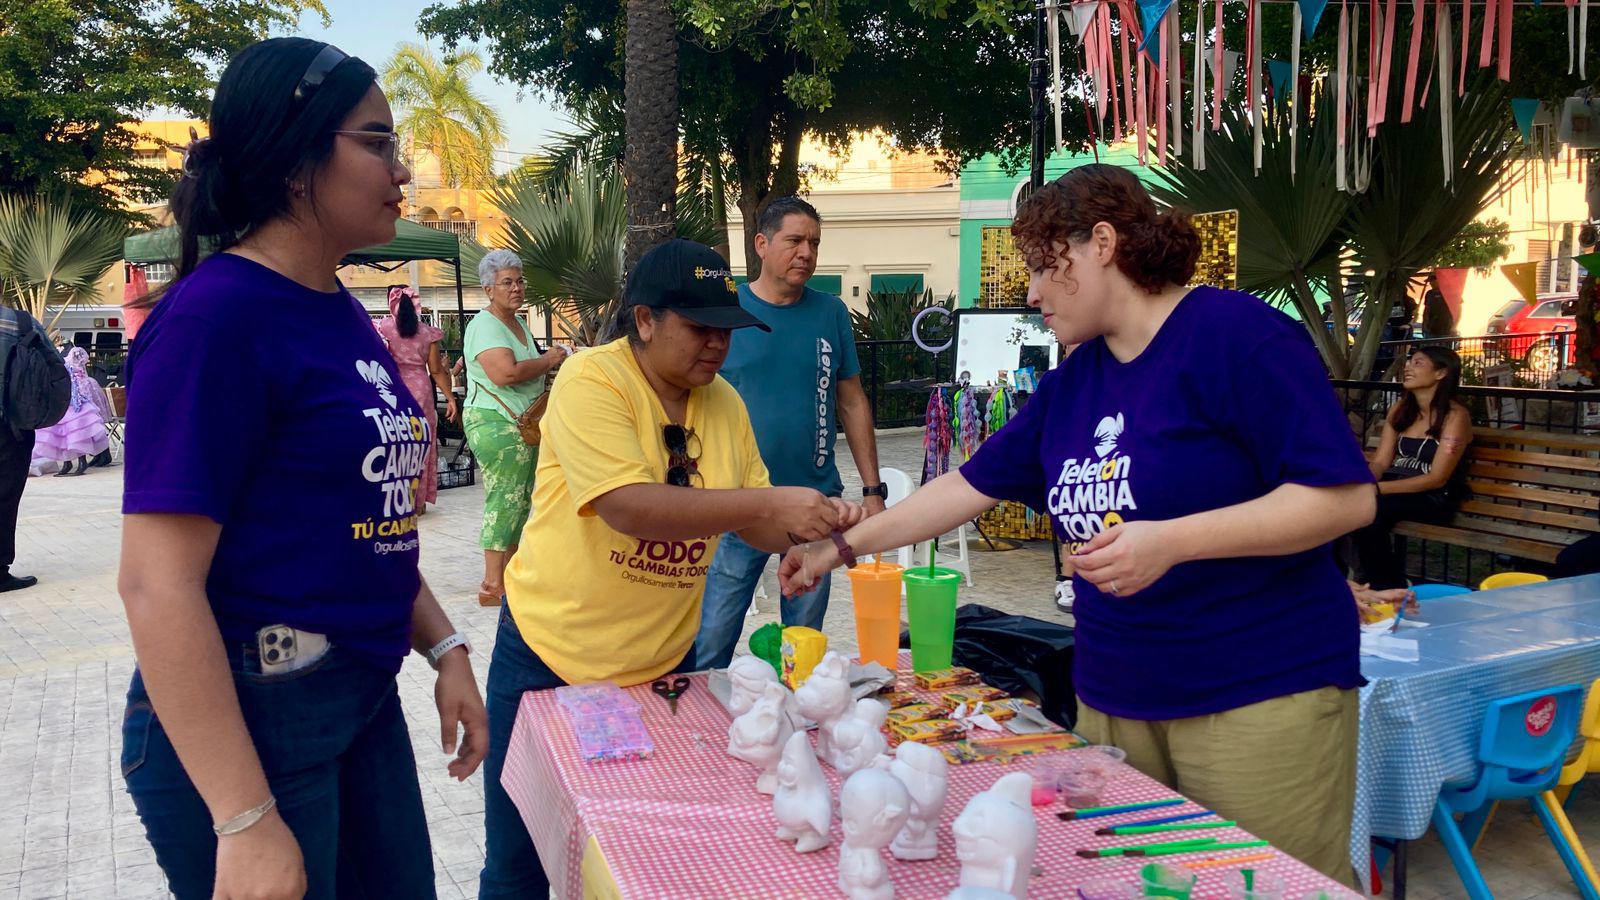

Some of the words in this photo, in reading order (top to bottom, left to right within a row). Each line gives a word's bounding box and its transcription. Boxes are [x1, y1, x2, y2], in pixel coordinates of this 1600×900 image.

[817, 338, 832, 467] Aeropostale
[362, 407, 431, 444] Teletón
[1057, 451, 1131, 486] Teletón
[1047, 479, 1137, 515] CAMBIA
[351, 517, 374, 539] TÚ
[609, 550, 625, 565] TÚ
[628, 557, 683, 577] CAMBIAS
[635, 537, 706, 565] TODO
[621, 570, 677, 589] Orgullosamente
